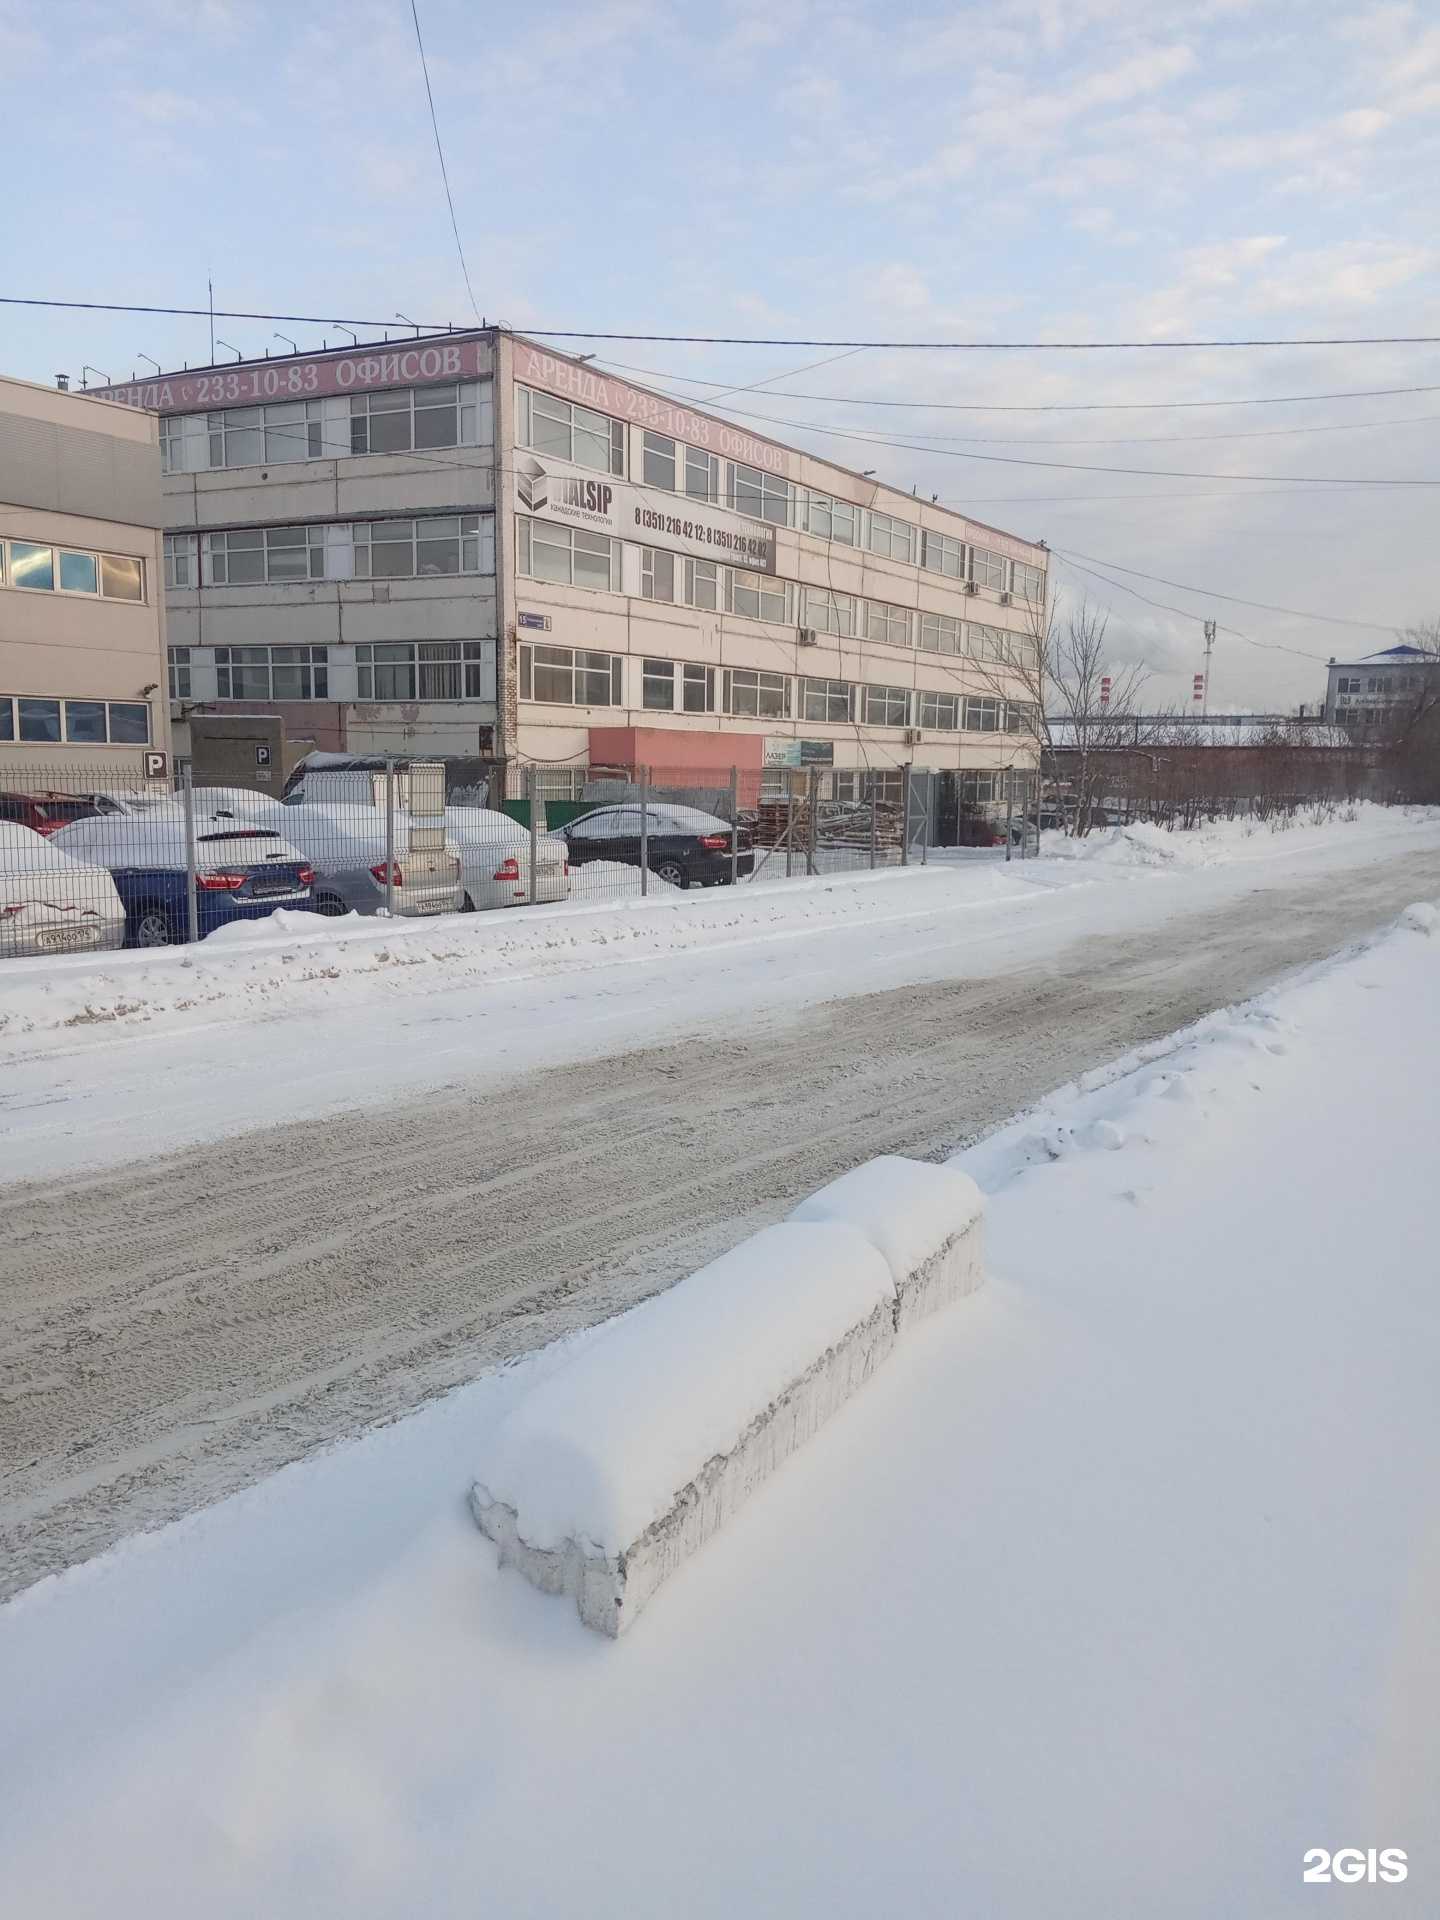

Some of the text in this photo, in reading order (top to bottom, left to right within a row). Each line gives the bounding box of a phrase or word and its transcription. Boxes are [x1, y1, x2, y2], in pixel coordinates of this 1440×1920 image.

[90, 347, 462, 411] РЕНДА 233-10-83 ОФИСОВ
[527, 353, 783, 471] АРЕНДА 233-10-83 ОФИСОВ
[634, 507, 641, 525] 8
[642, 509, 665, 532] (351)
[666, 515, 681, 536] 216
[682, 521, 693, 539] 42
[706, 527, 712, 544] 8
[713, 528, 732, 549] (351)
[733, 534, 746, 553] 216
[747, 538, 756, 555] 42
[148, 755, 164, 776] P
